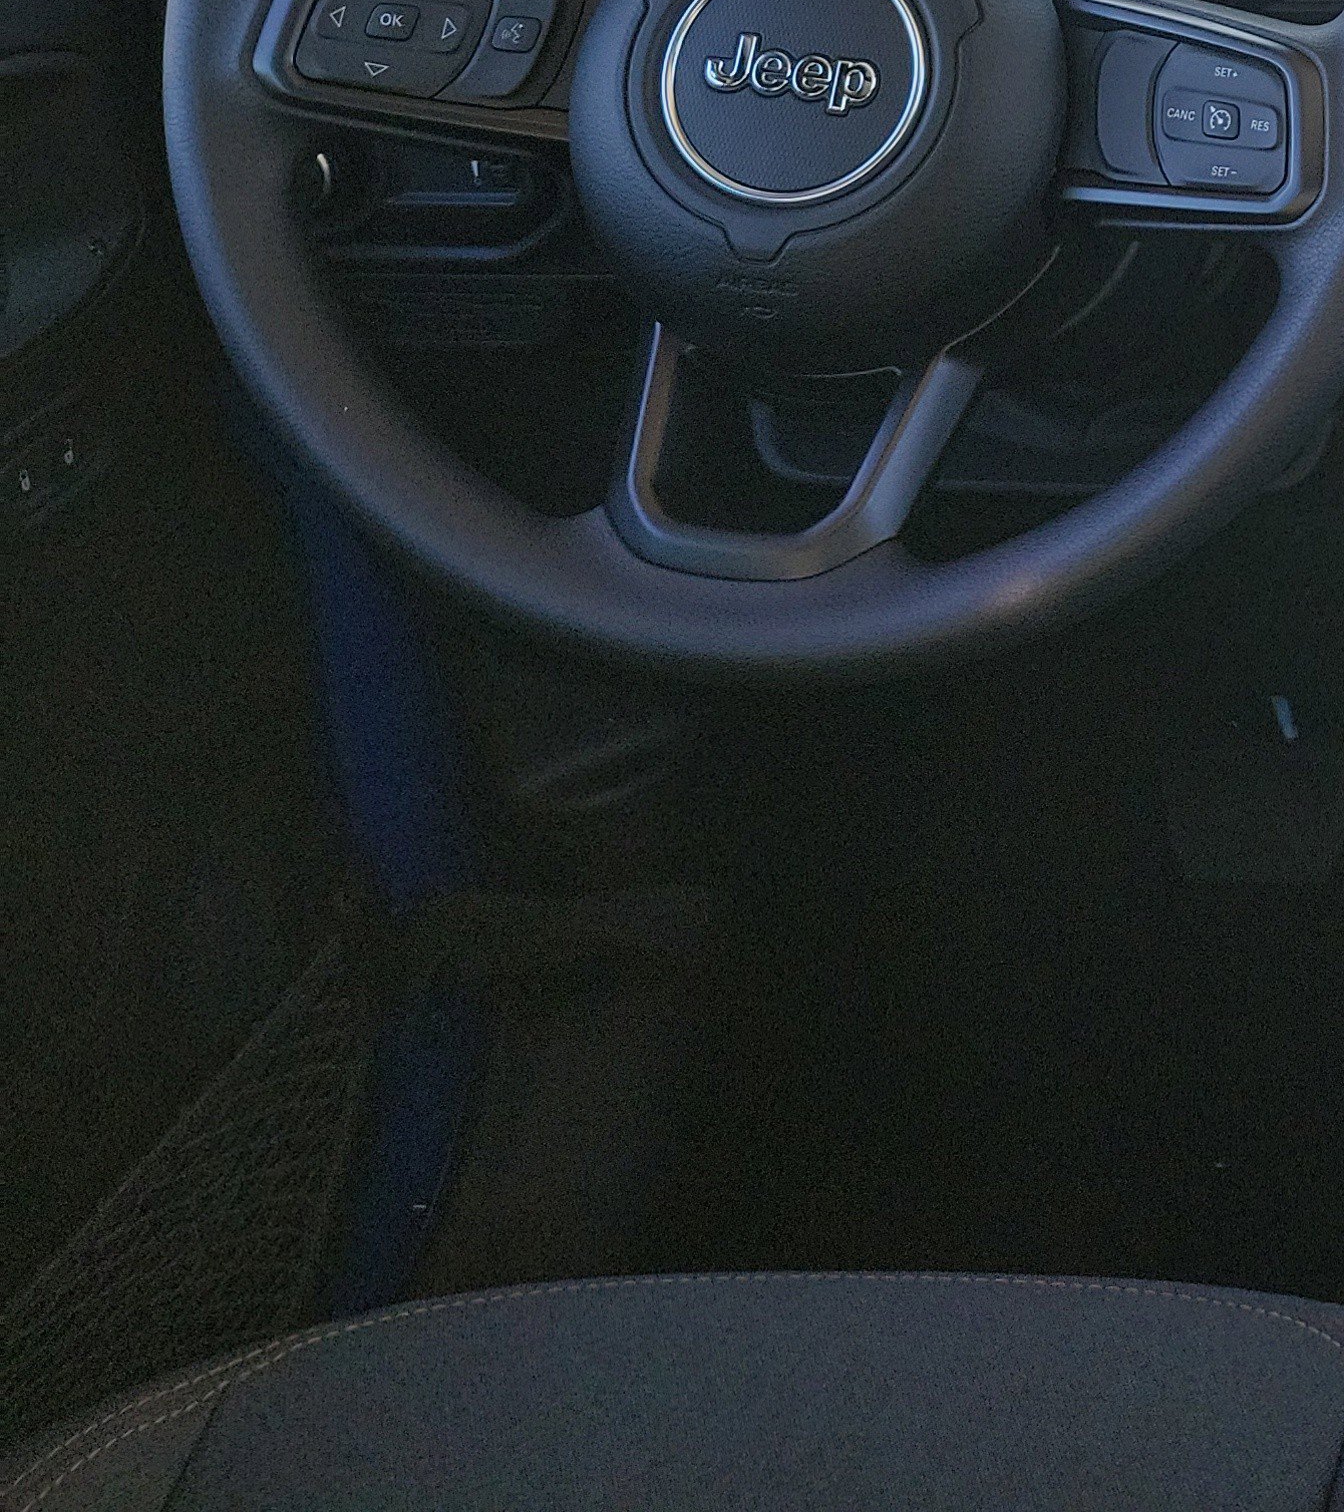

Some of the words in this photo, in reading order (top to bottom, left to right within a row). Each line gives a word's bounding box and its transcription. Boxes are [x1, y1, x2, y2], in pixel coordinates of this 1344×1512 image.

[380, 13, 404, 27] OK
[704, 33, 880, 115] Jeep
[1213, 66, 1240, 79] SET+
[1166, 107, 1195, 123] CANC
[1250, 119, 1270, 133] RES
